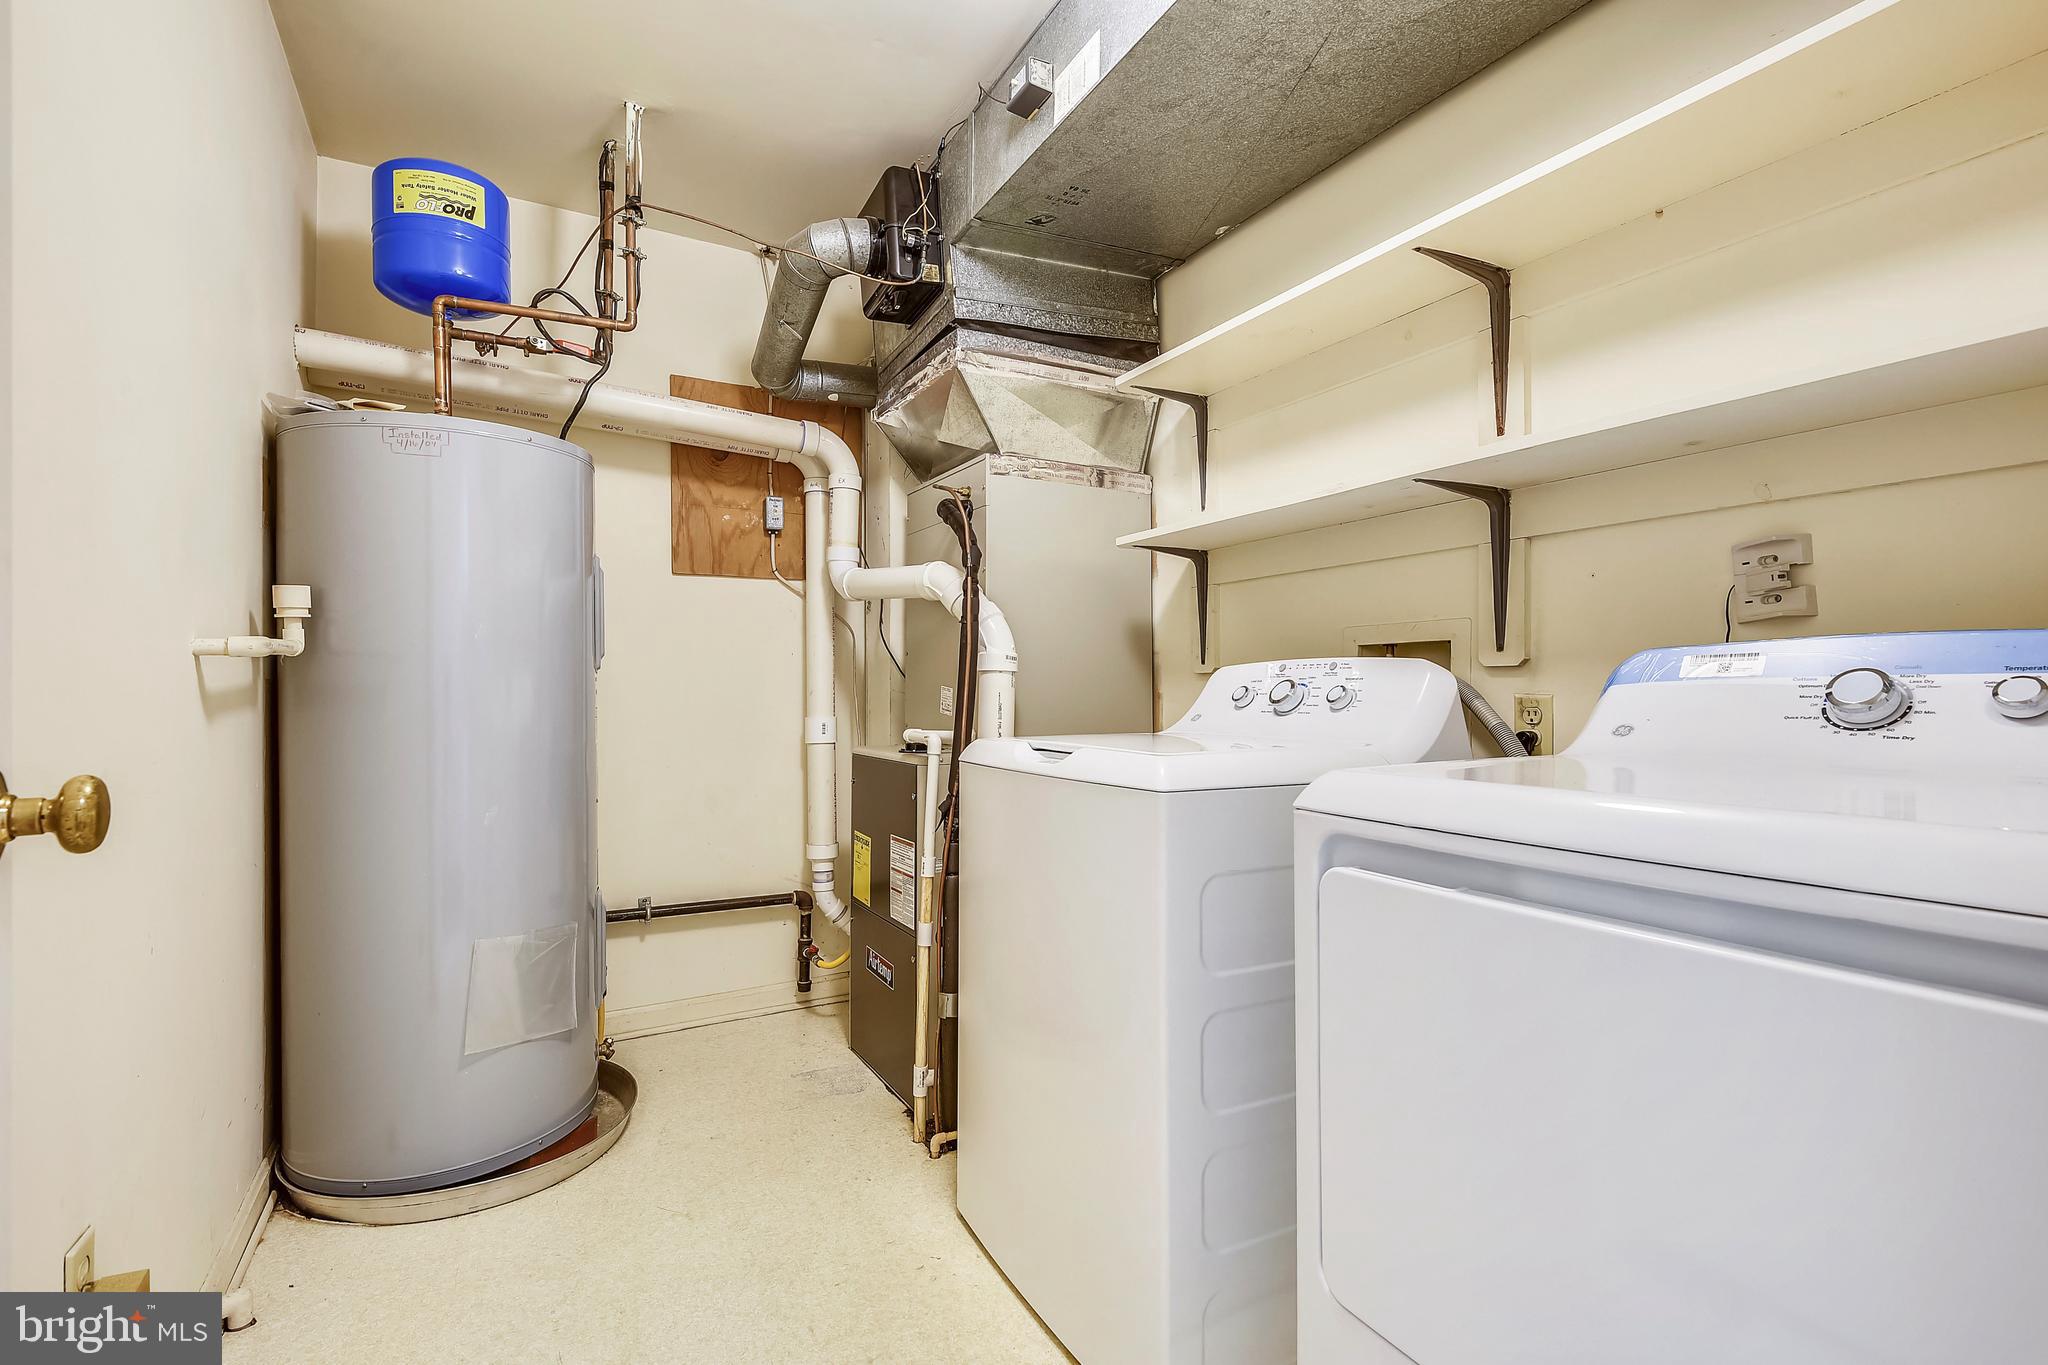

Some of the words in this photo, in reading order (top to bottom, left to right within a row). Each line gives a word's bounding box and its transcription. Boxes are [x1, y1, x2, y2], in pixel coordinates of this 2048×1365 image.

[415, 183, 435, 191] Safety
[437, 186, 458, 196] Heater
[460, 192, 477, 202] Water
[416, 199, 476, 221] PROFLO
[388, 428, 441, 441] Installed
